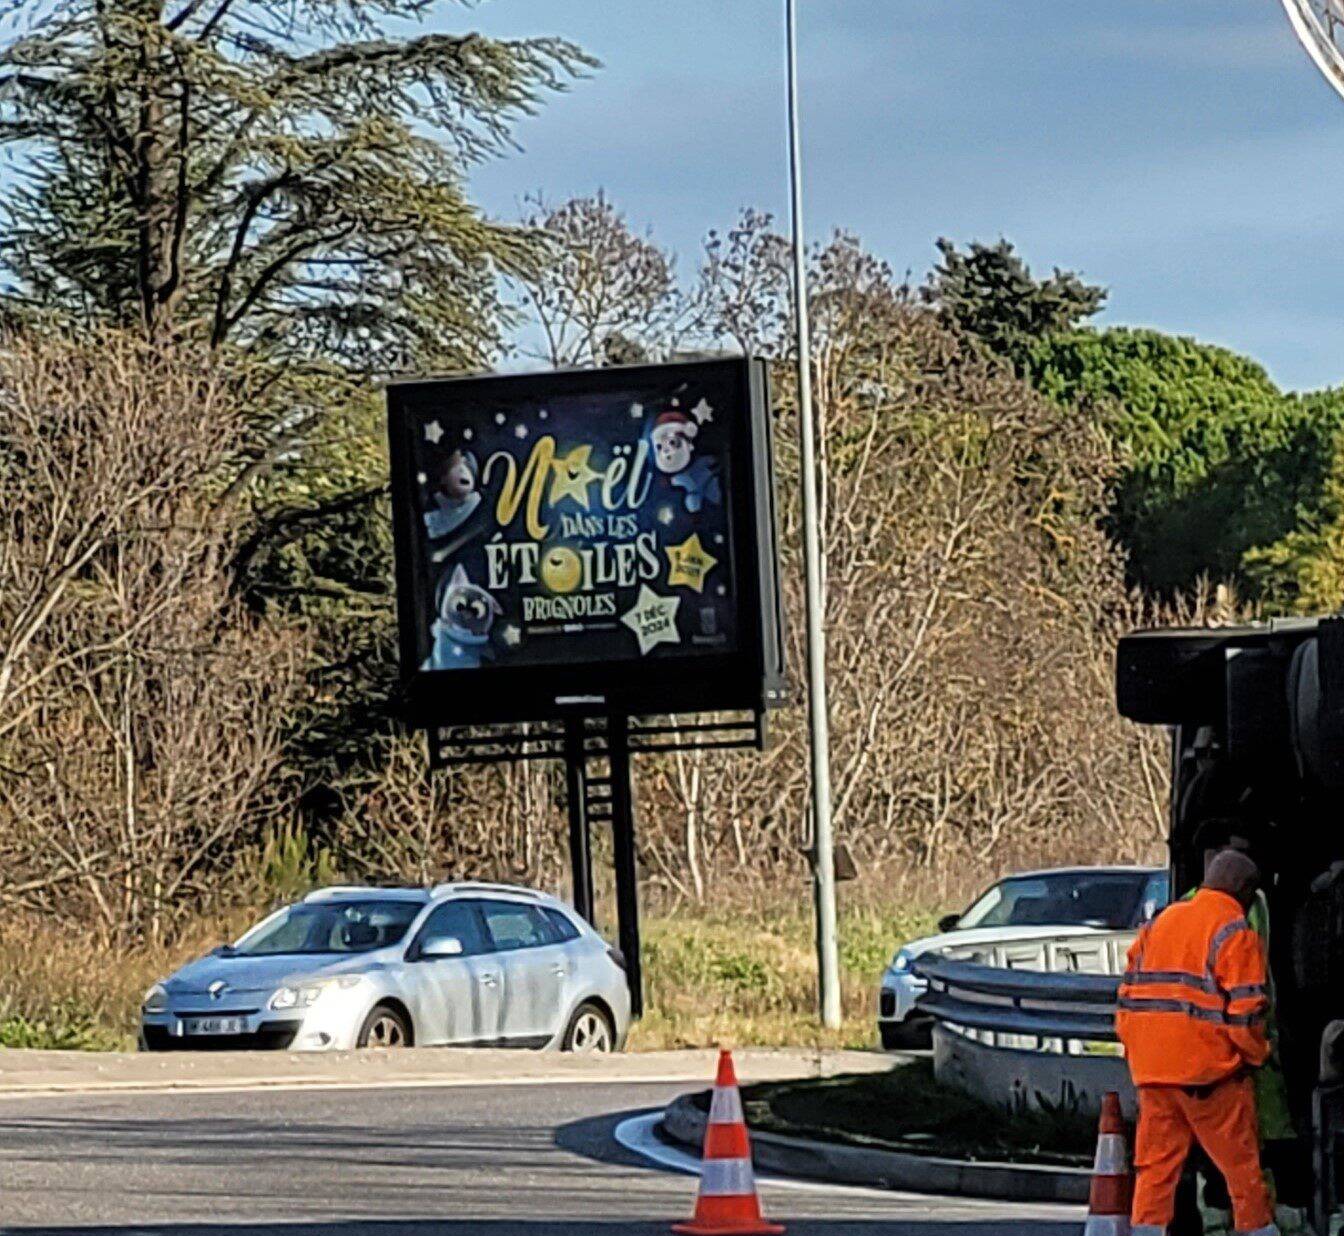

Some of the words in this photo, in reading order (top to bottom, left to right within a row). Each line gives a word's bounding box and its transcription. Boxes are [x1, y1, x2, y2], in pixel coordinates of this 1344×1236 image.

[560, 511, 604, 539] DANS
[607, 513, 638, 539] LES
[522, 592, 617, 622] BRIGNOLES
